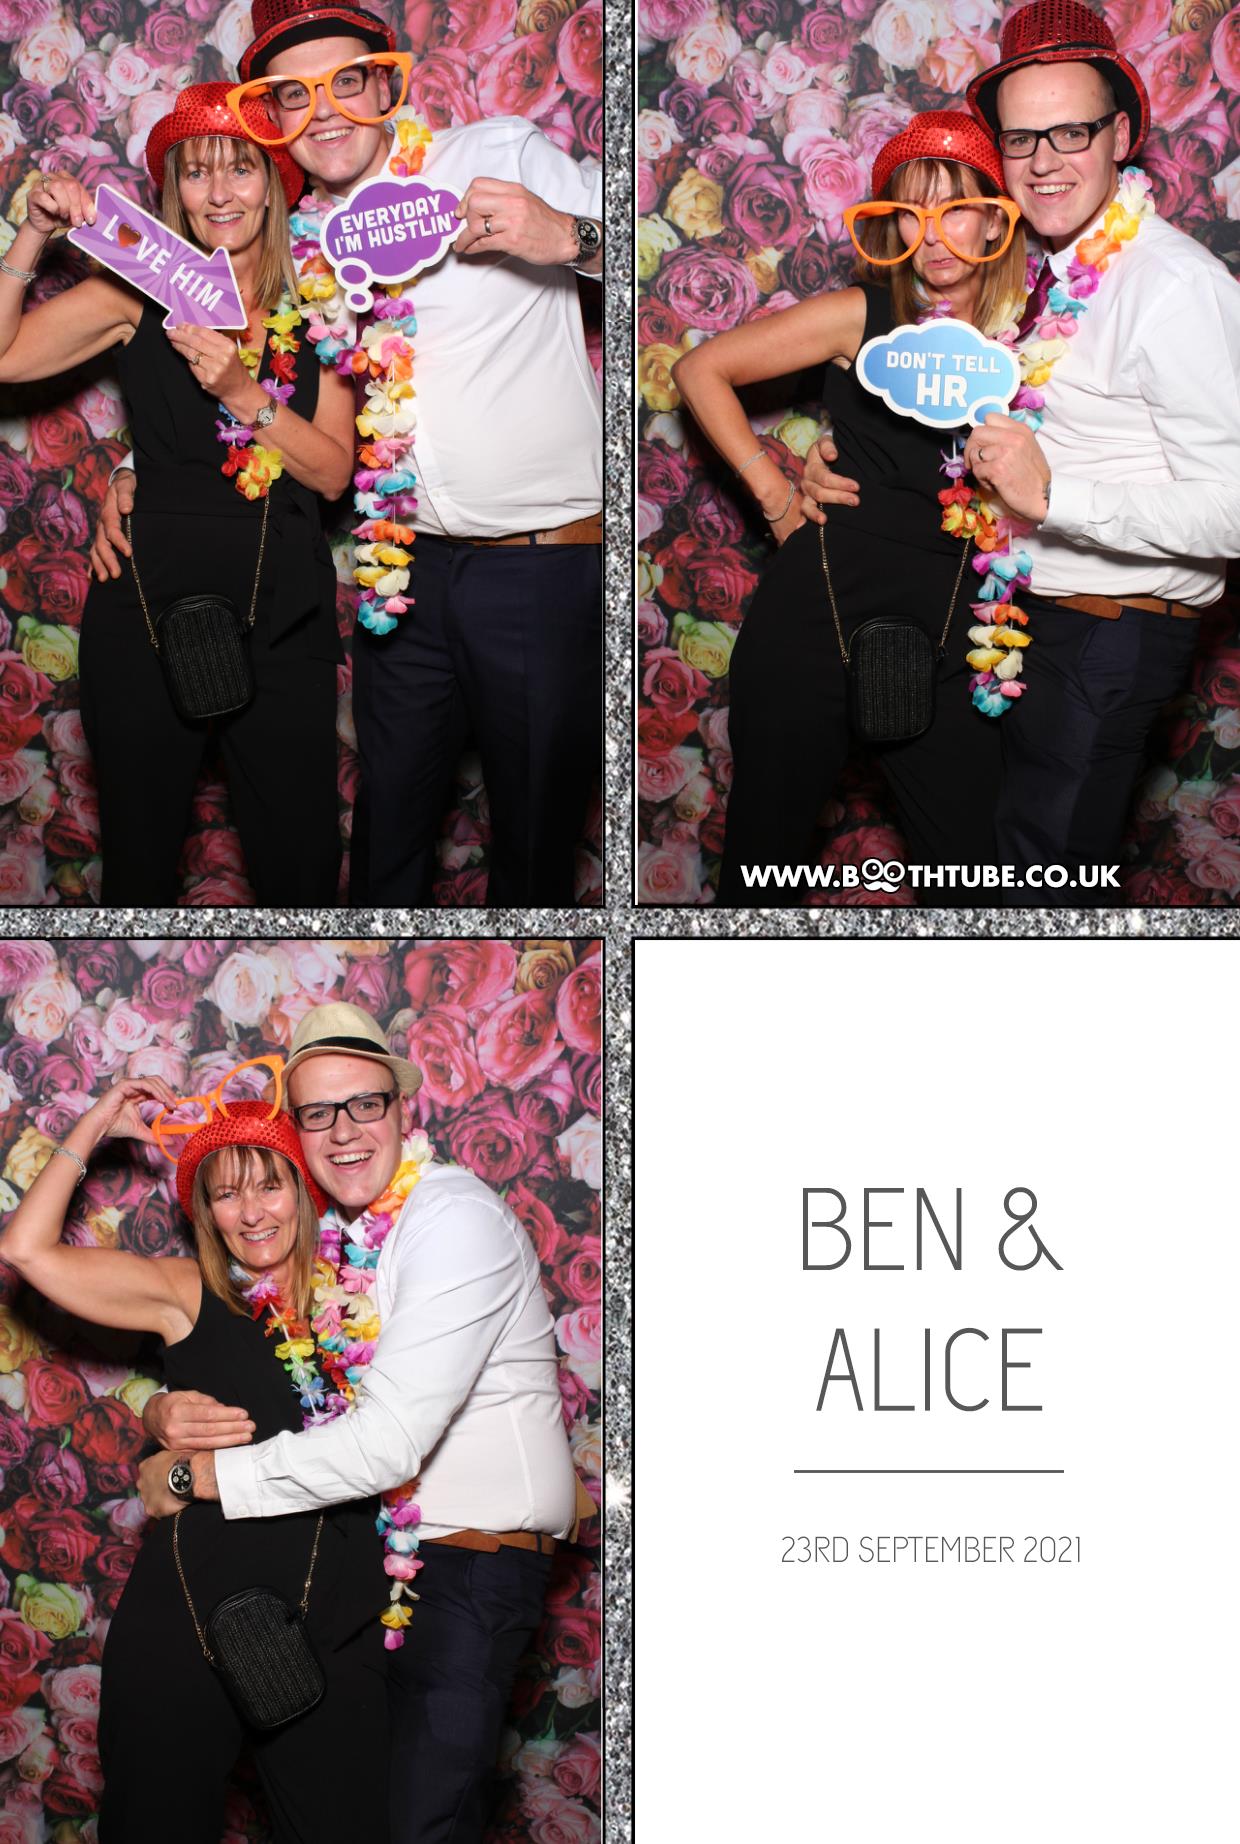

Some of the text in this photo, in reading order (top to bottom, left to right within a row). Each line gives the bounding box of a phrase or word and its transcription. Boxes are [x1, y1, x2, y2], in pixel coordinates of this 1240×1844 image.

[334, 210, 455, 255] I'M HUSTLIN'
[340, 194, 440, 233] EVERYDAY
[169, 263, 224, 312] HIM
[886, 351, 1000, 373] DON'T TELL
[916, 373, 968, 407] HR
